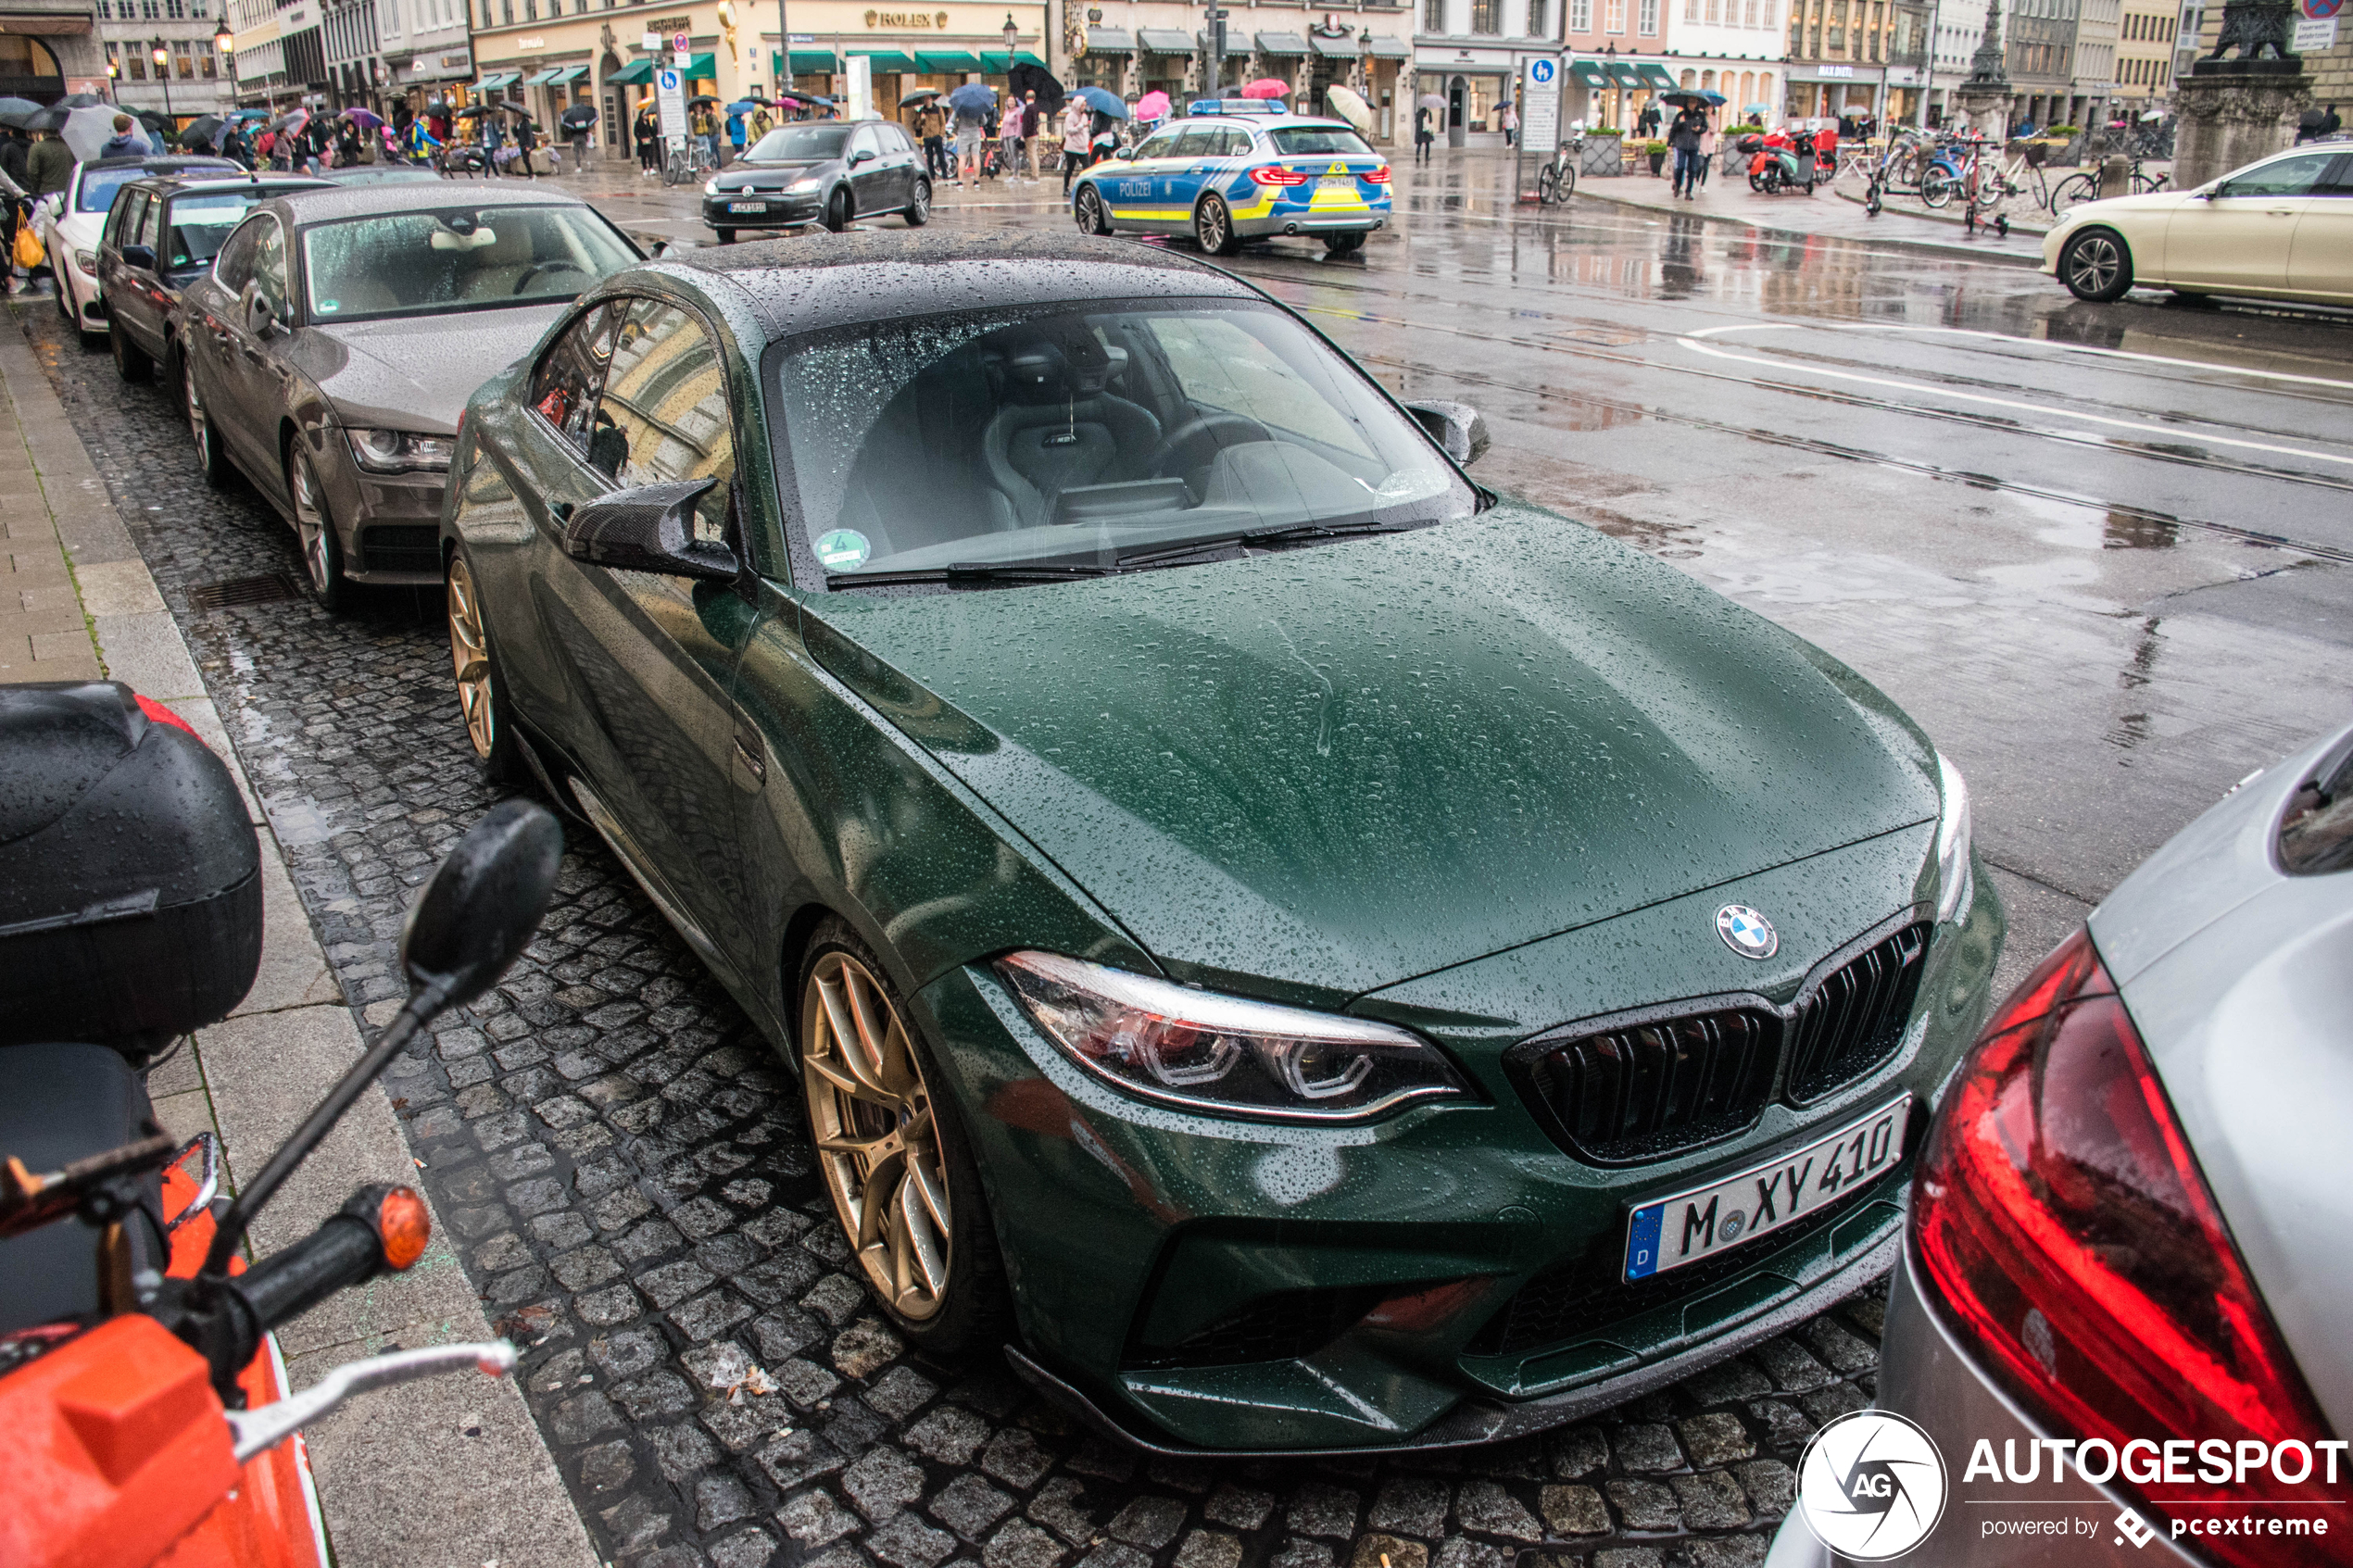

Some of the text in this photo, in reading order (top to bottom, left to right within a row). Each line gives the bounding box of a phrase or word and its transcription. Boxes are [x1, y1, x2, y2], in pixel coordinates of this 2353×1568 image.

[880, 12, 930, 27] ROLEX
[1119, 181, 1151, 197] POLIZEI
[834, 534, 848, 550] 4
[1680, 1114, 1894, 1256] M XY 410
[1637, 1249, 1649, 1266] D
